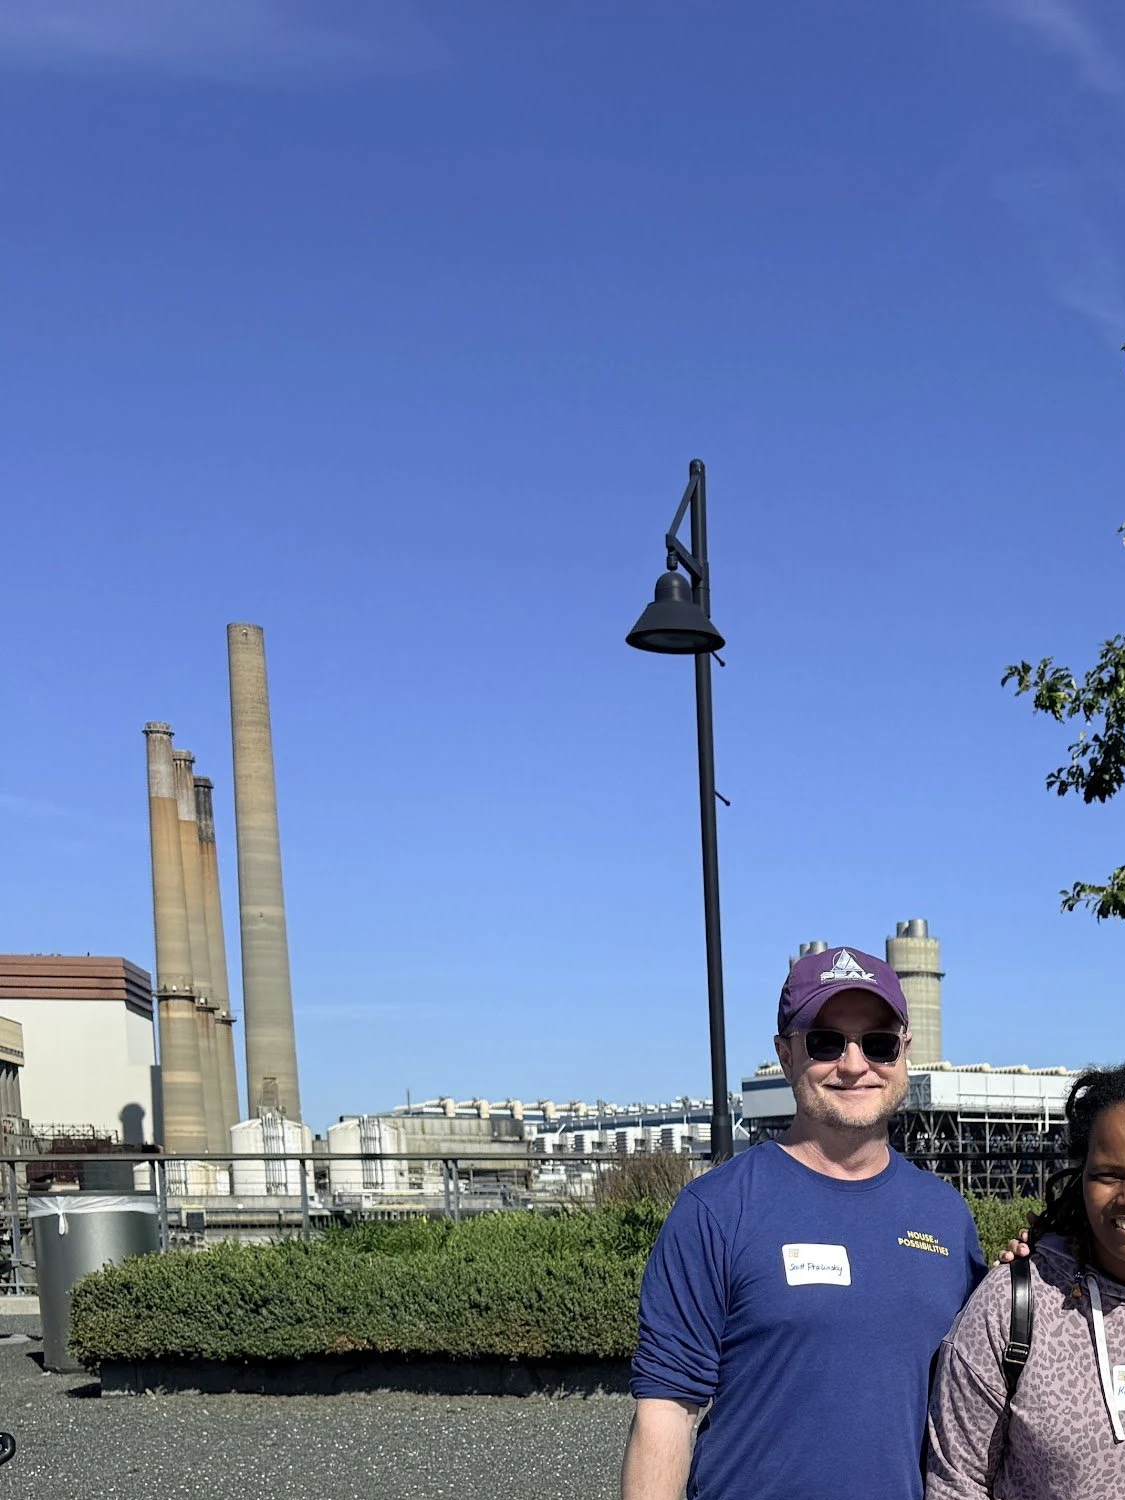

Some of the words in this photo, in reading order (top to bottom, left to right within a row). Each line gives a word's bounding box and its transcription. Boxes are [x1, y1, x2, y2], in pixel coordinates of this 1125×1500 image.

[820, 971, 877, 982] PEAK
[906, 1230, 935, 1243] HOUSE
[897, 1237, 950, 1256] POSSIBILITIES
